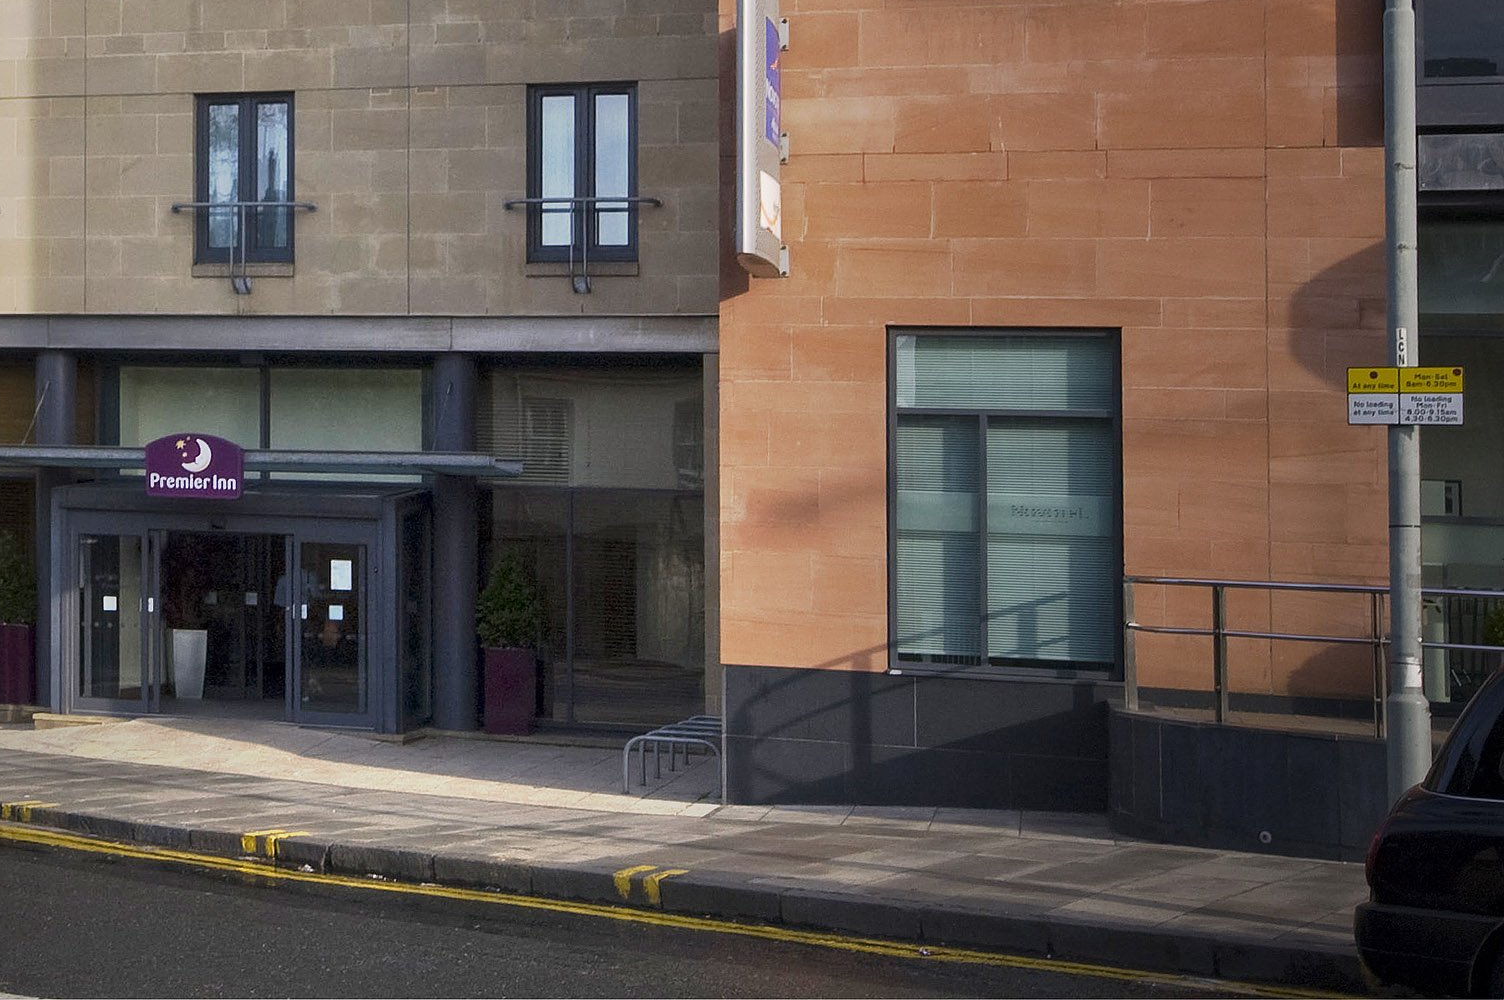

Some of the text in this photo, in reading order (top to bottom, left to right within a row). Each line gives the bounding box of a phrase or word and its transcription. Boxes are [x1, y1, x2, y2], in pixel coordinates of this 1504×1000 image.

[1424, 395, 1452, 403] loading
[1366, 401, 1394, 409] loading
[149, 472, 237, 490] Premier Inn
